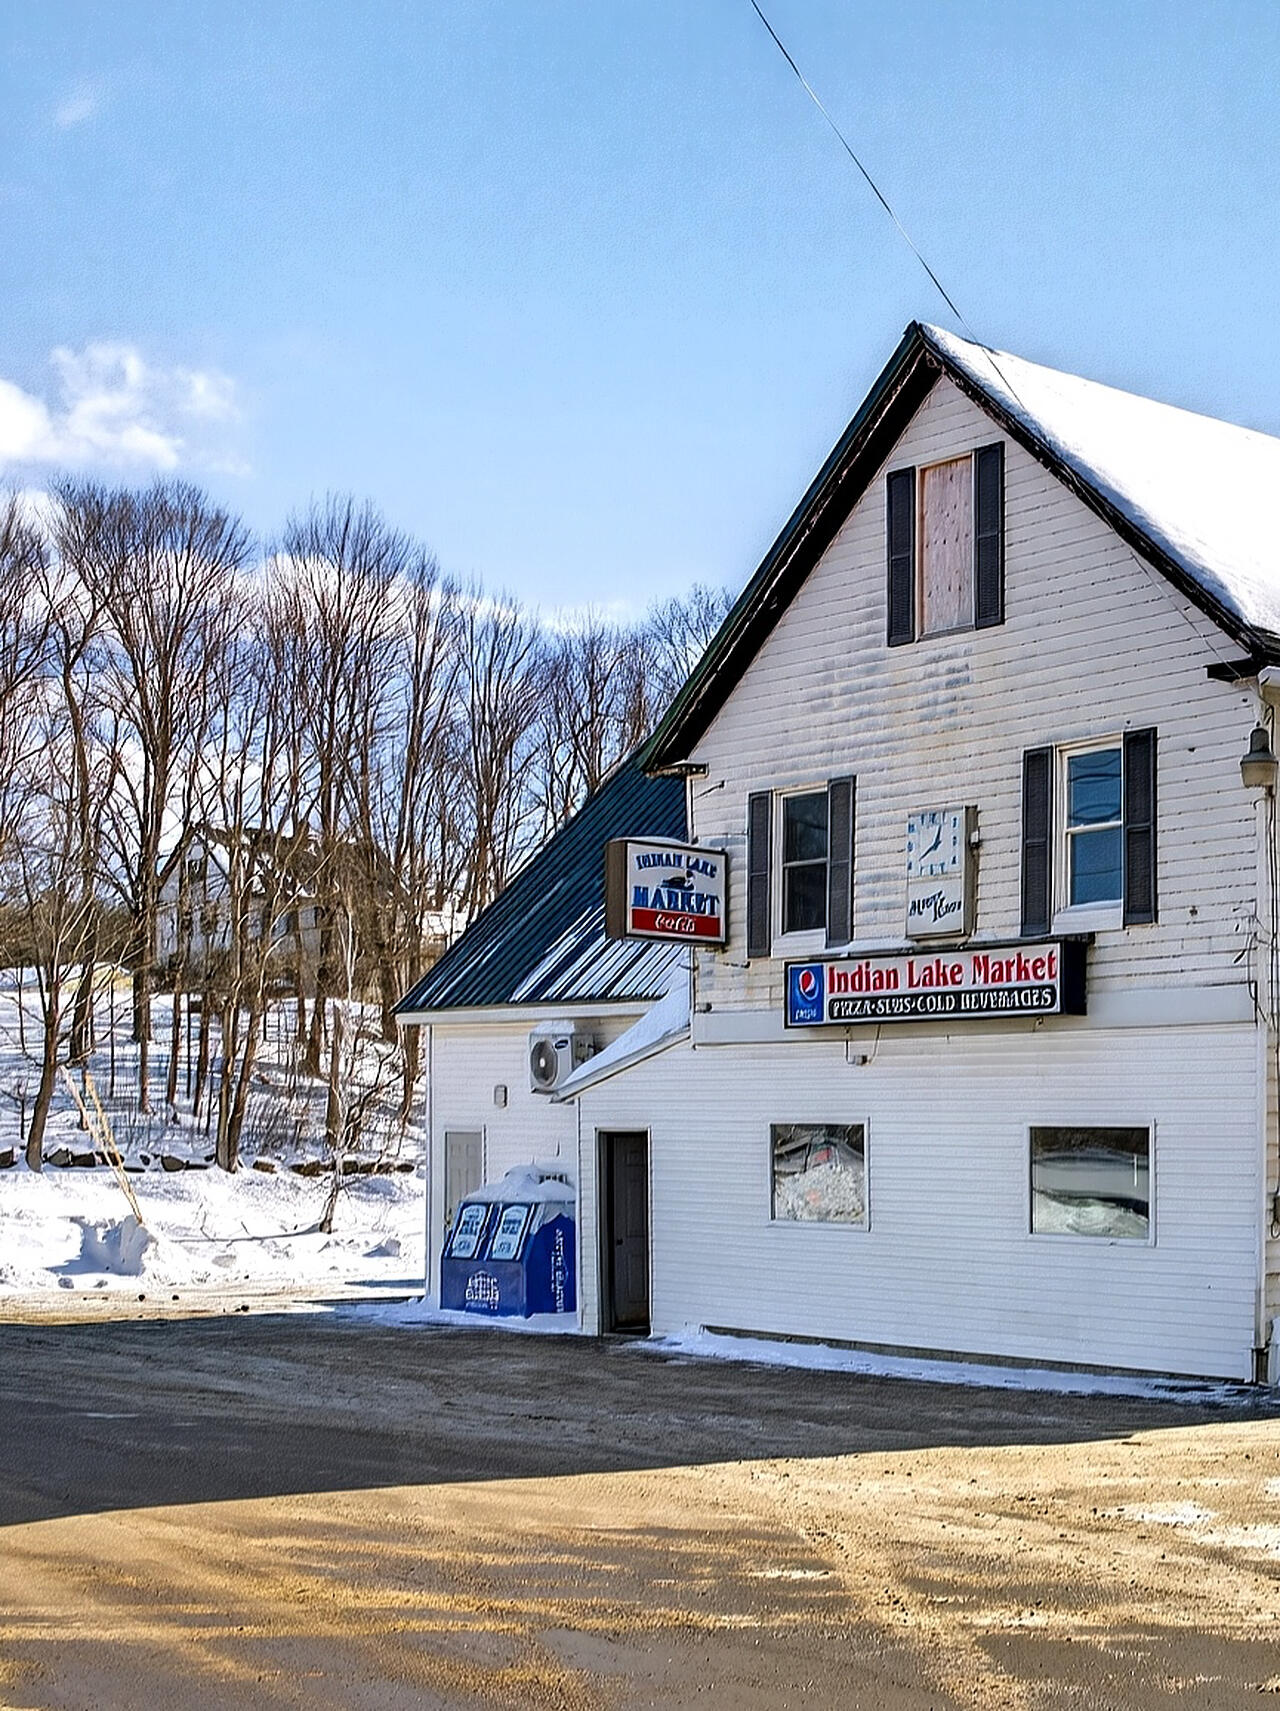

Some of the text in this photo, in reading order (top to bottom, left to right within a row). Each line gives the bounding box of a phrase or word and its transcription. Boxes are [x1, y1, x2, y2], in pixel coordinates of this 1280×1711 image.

[828, 949, 1058, 994] Indian Lake Market
[917, 994, 955, 1012] COLD
